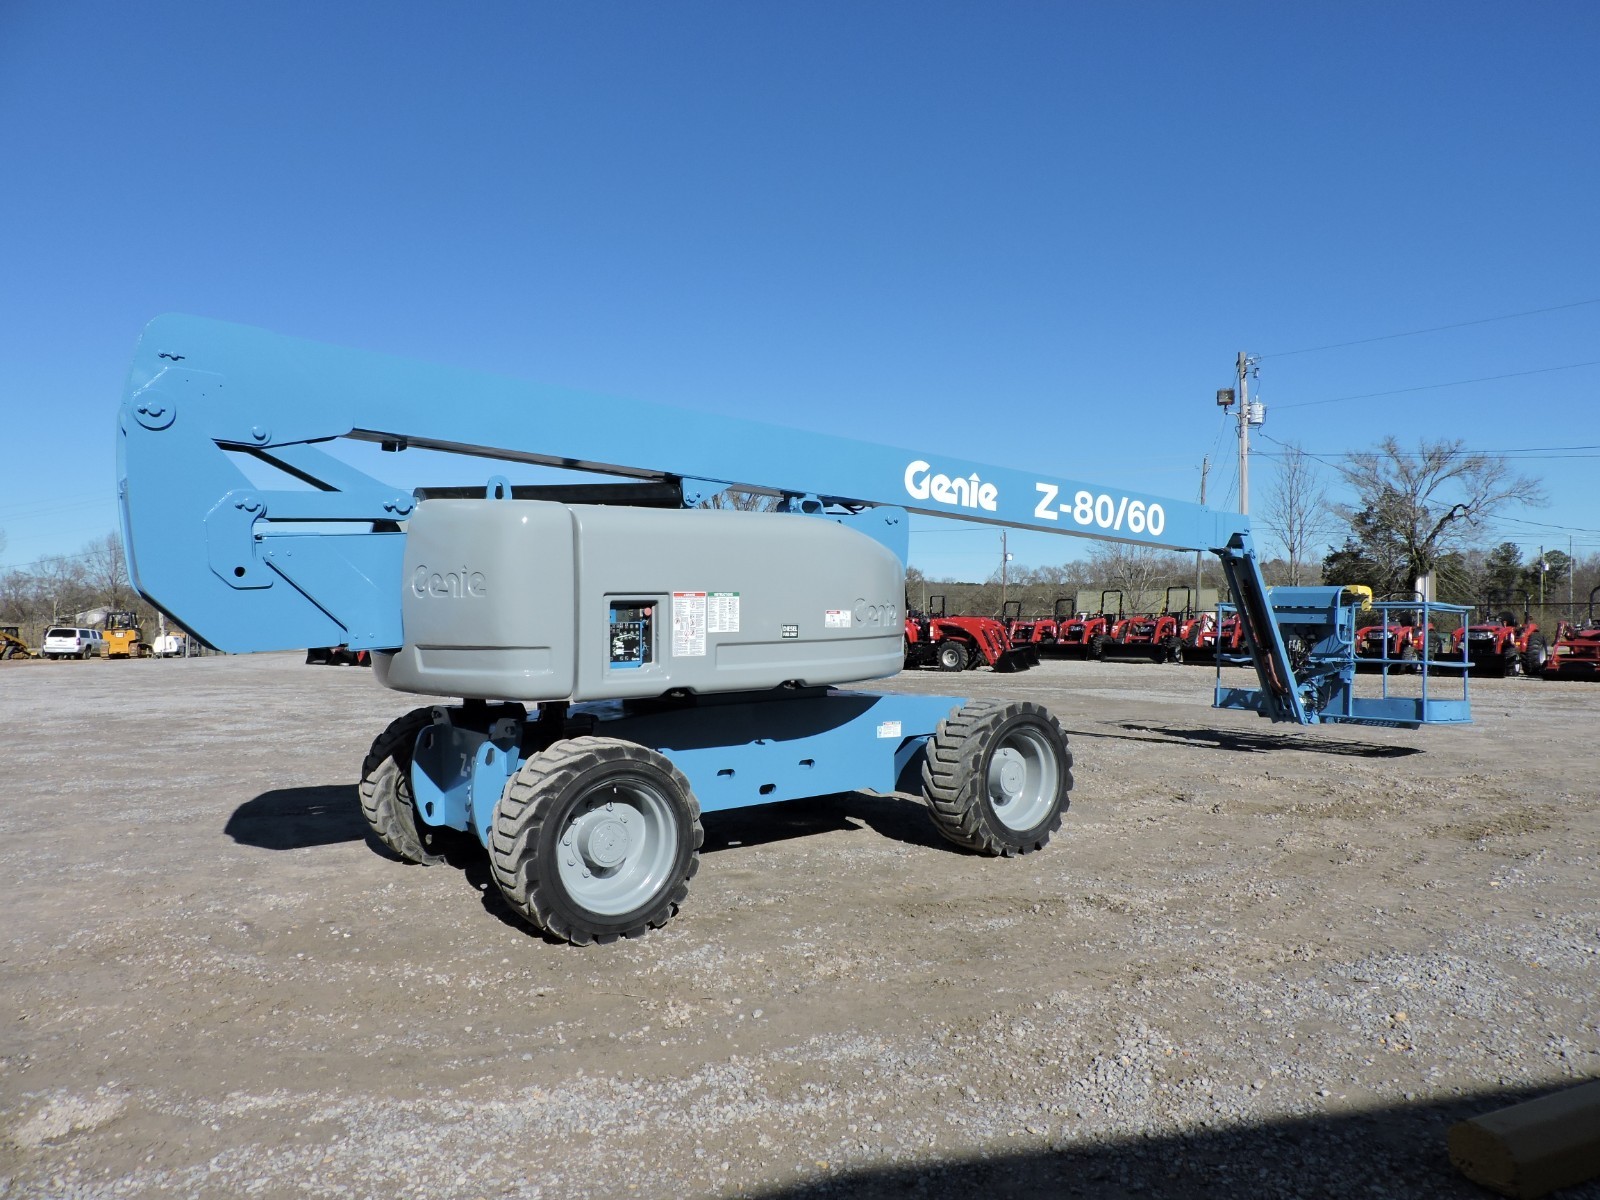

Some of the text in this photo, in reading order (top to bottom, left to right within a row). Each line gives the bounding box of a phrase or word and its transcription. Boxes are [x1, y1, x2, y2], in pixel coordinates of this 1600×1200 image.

[904, 460, 1165, 536] Genie Z-80/60
[411, 564, 487, 599] Genie
[854, 597, 897, 628] Genie
